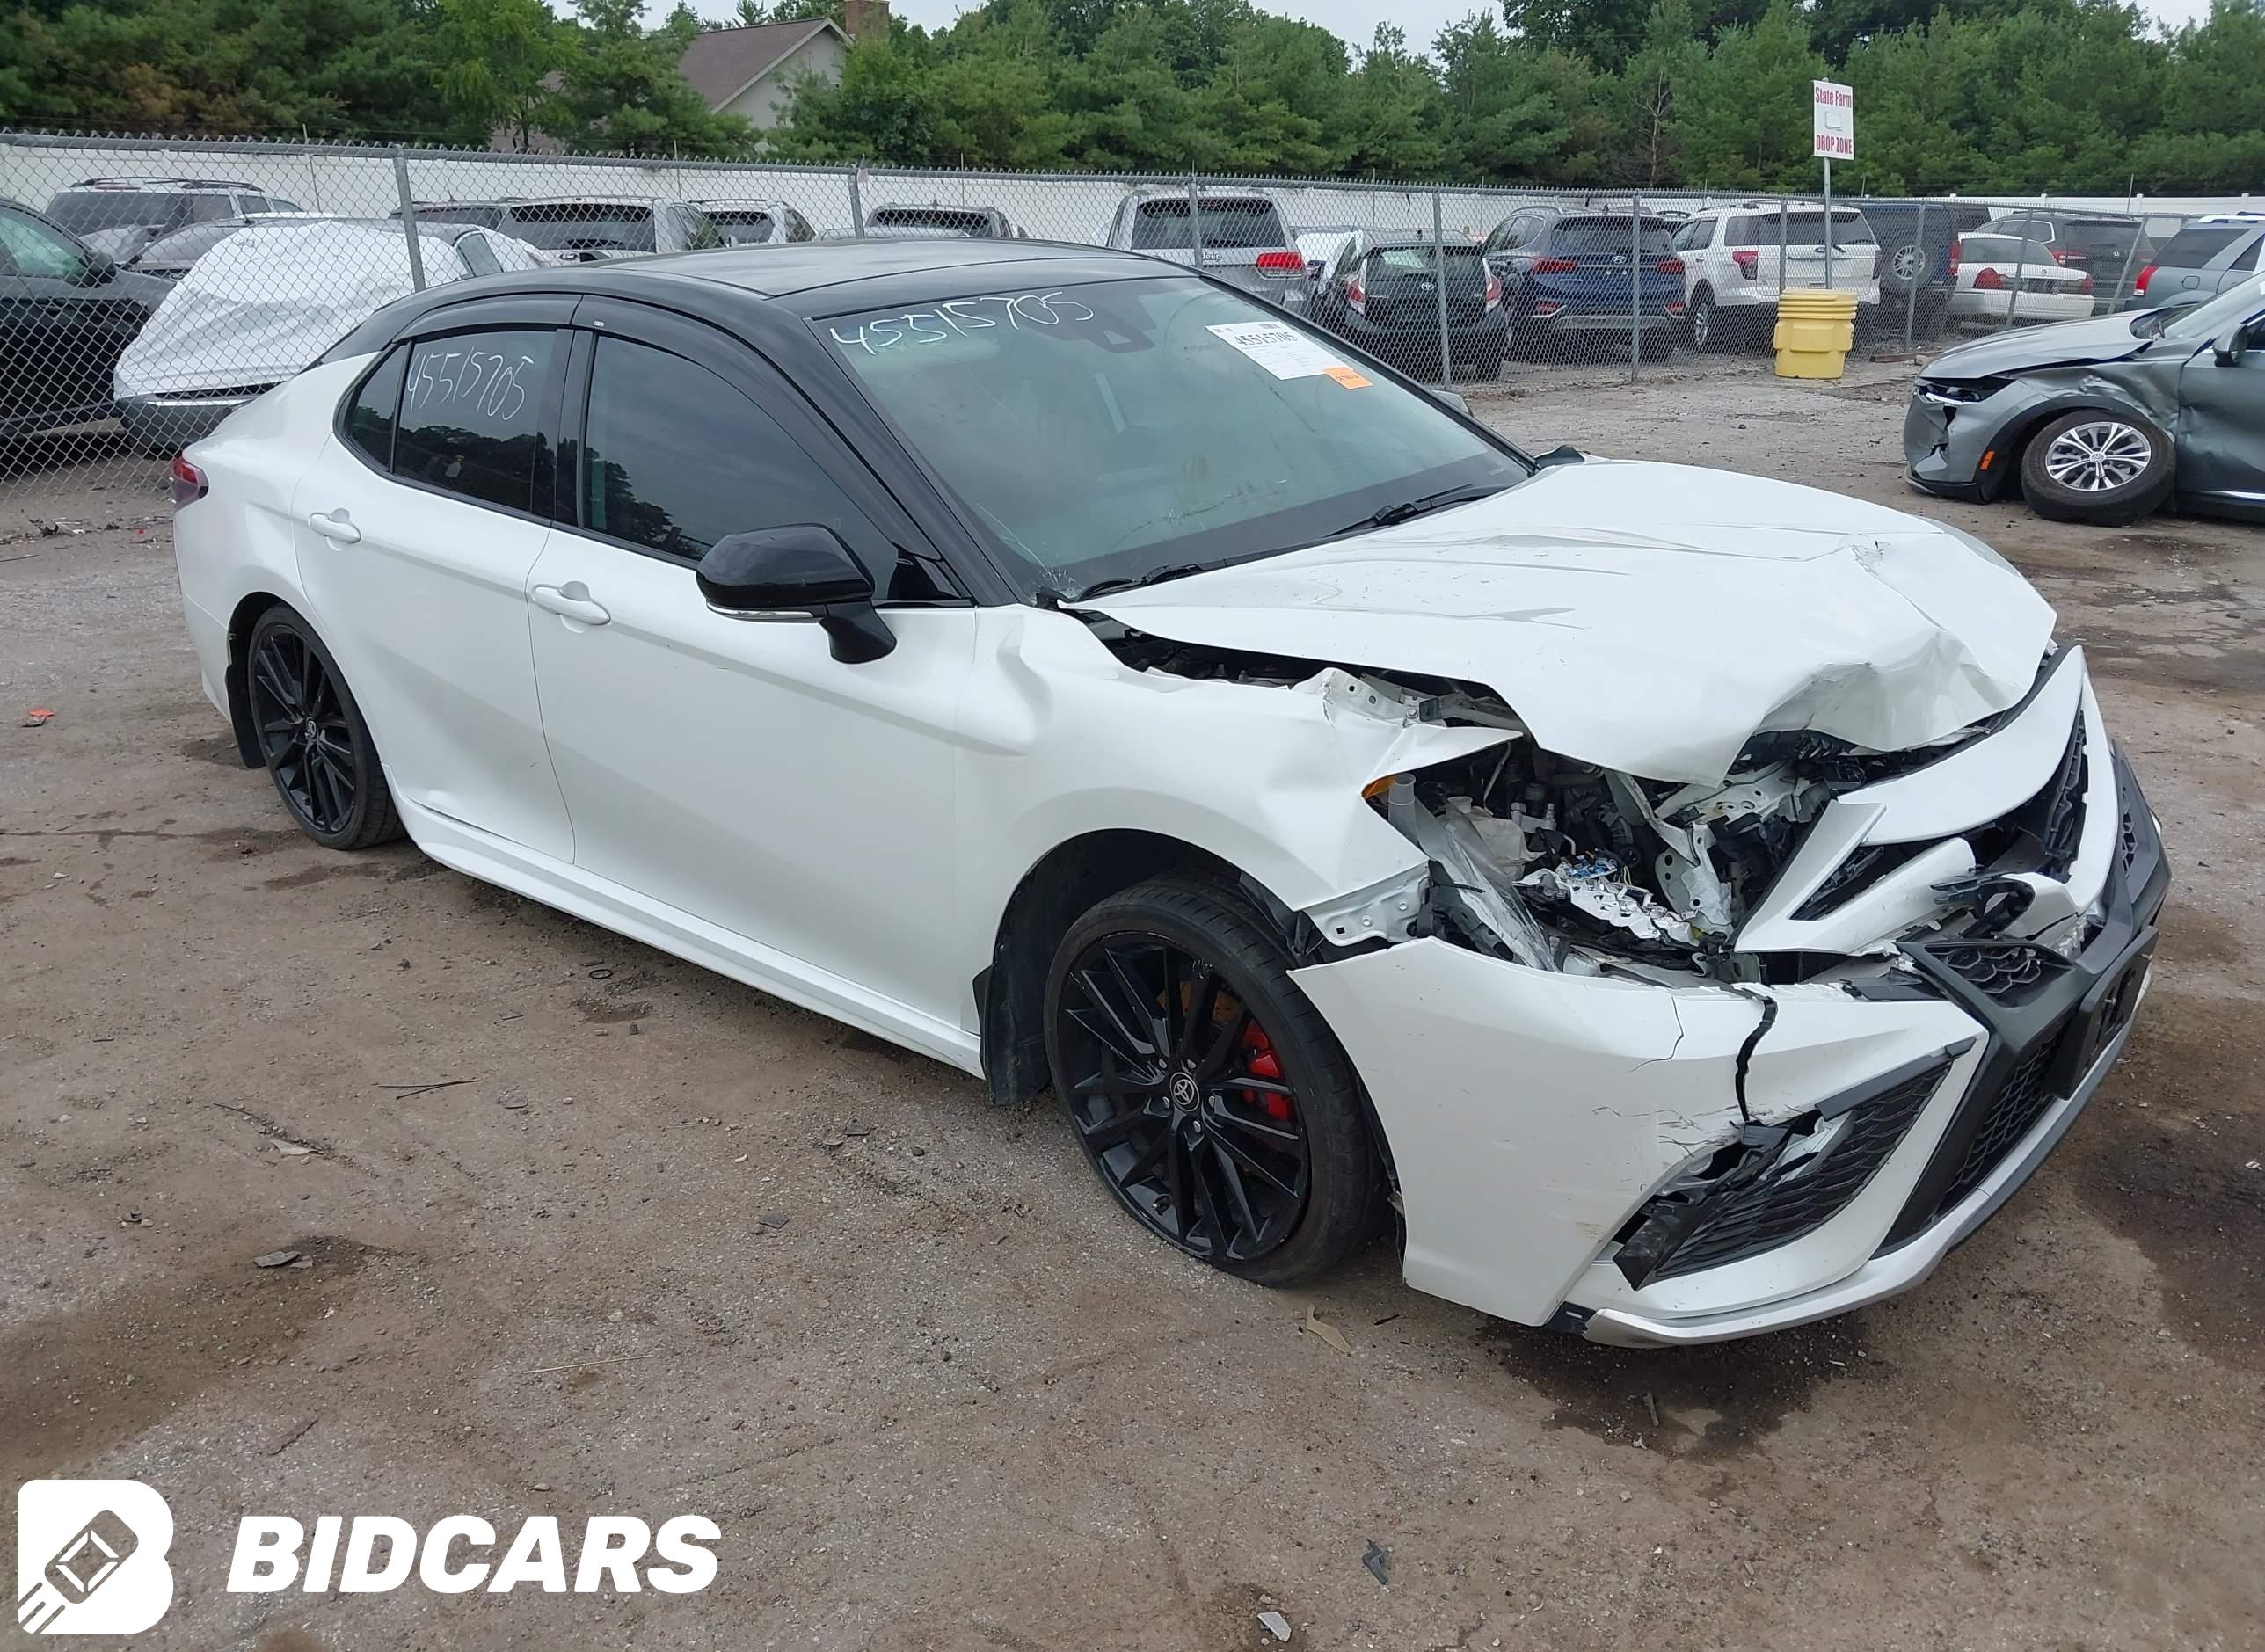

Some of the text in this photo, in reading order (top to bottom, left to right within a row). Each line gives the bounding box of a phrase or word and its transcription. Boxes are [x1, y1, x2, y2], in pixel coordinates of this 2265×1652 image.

[1815, 86, 1853, 108] State Farm
[1816, 135, 1853, 154] DROP ZONE
[829, 291, 1094, 355] 45515705
[406, 346, 535, 421] 45515705
